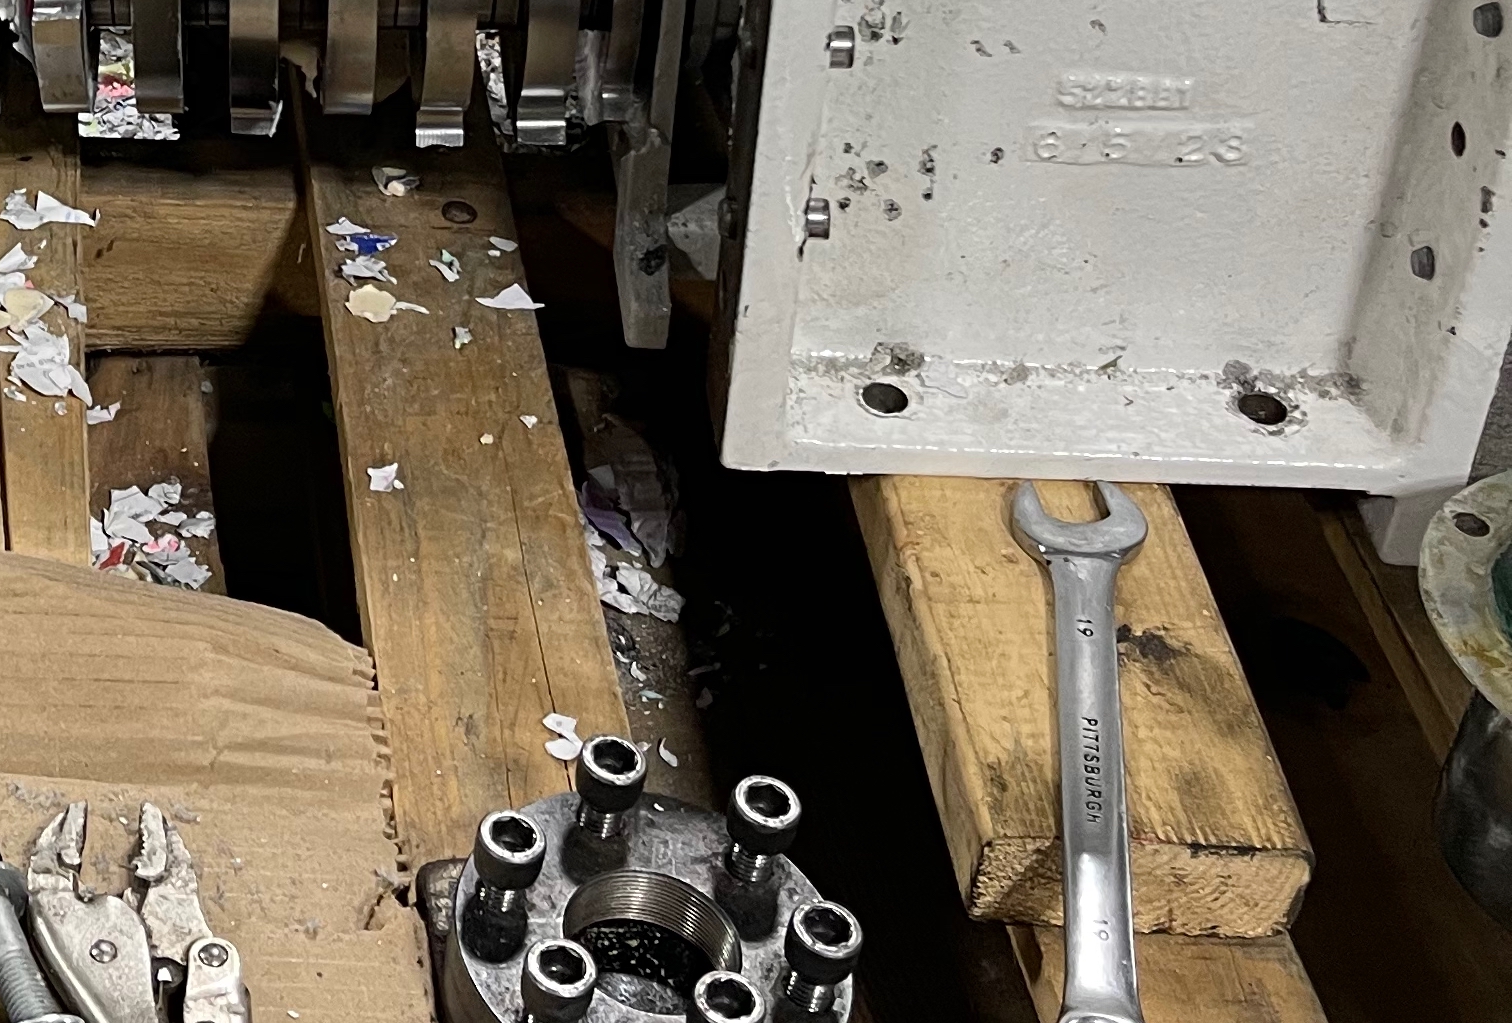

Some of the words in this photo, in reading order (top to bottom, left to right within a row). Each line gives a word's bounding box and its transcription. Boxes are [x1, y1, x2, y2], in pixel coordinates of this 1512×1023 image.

[1076, 618, 1094, 638] 19
[1081, 716, 1103, 824] PITTSBURGH
[1092, 919, 1110, 941] 19
